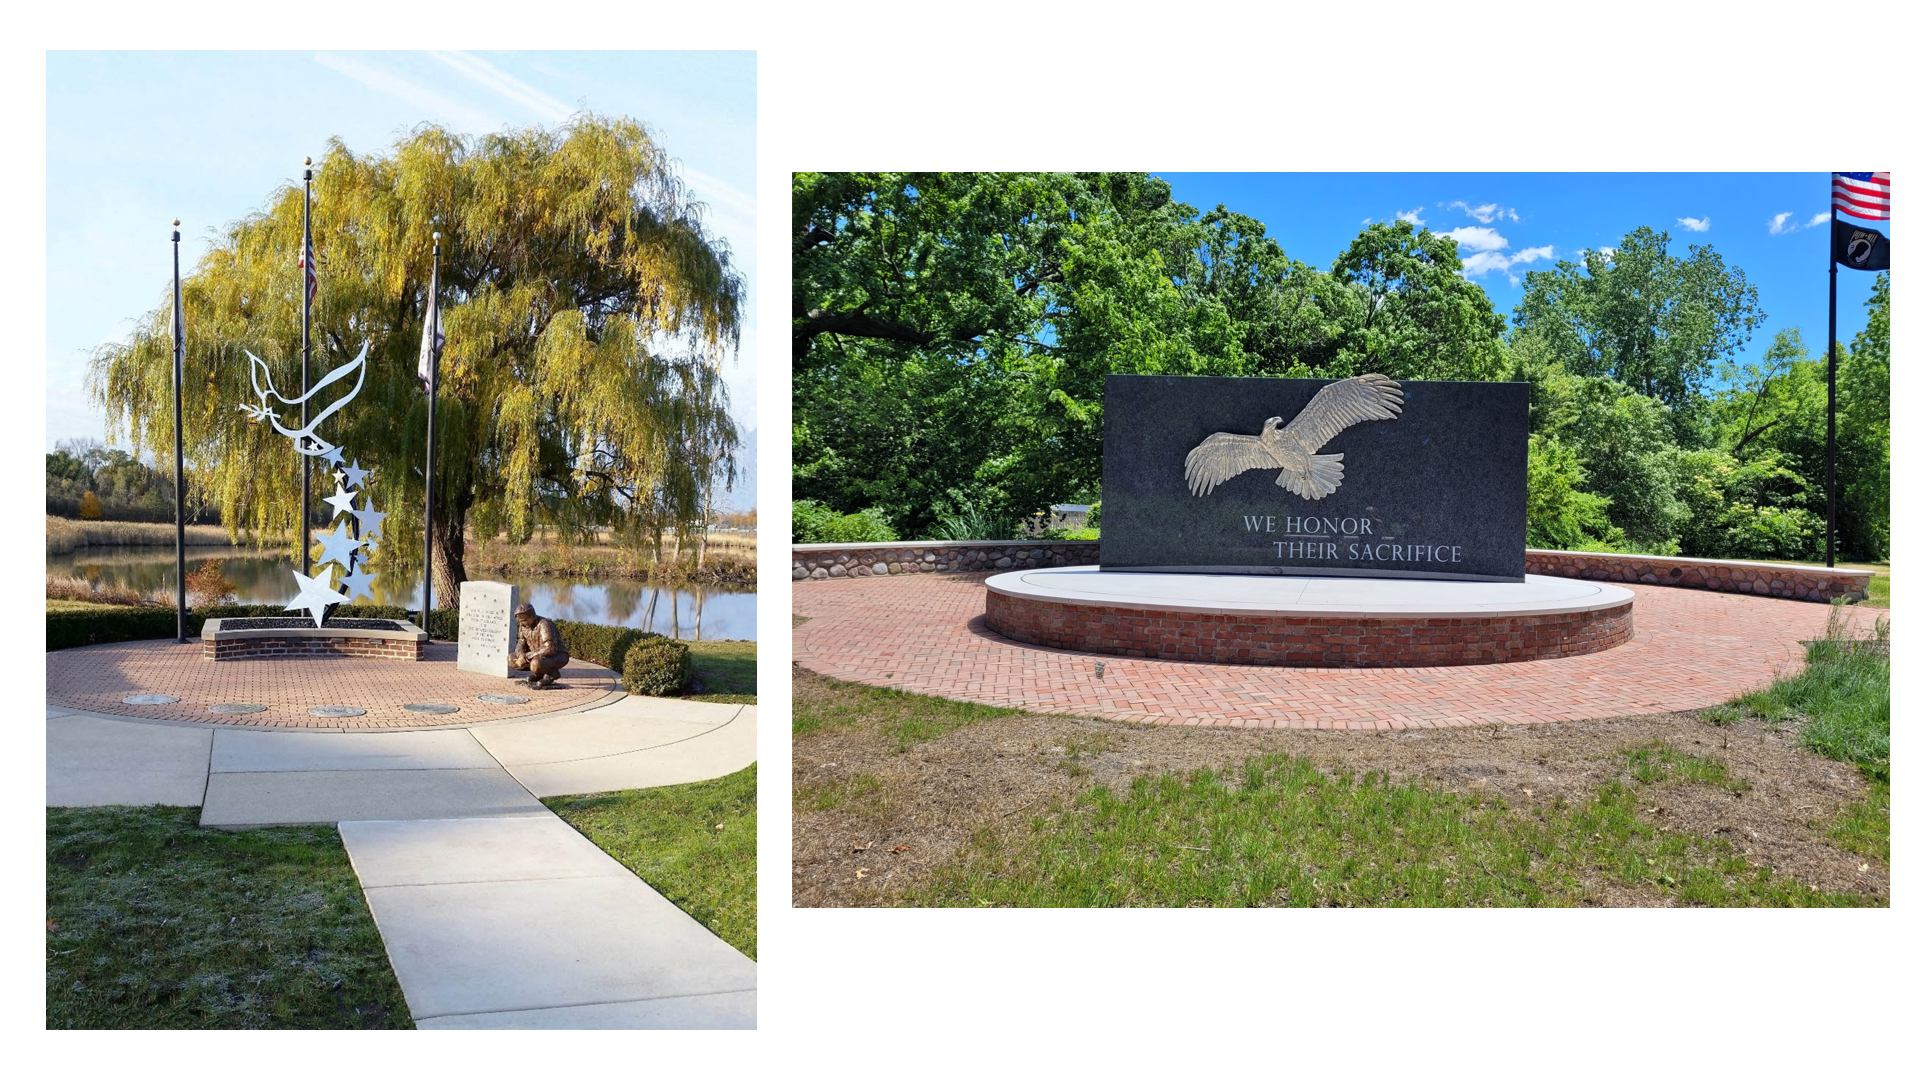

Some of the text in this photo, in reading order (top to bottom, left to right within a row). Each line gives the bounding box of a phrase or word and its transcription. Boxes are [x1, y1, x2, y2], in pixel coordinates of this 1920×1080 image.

[1243, 515, 1373, 535] WE HONOR
[1273, 541, 1462, 563] THEIR SACRIFICE
